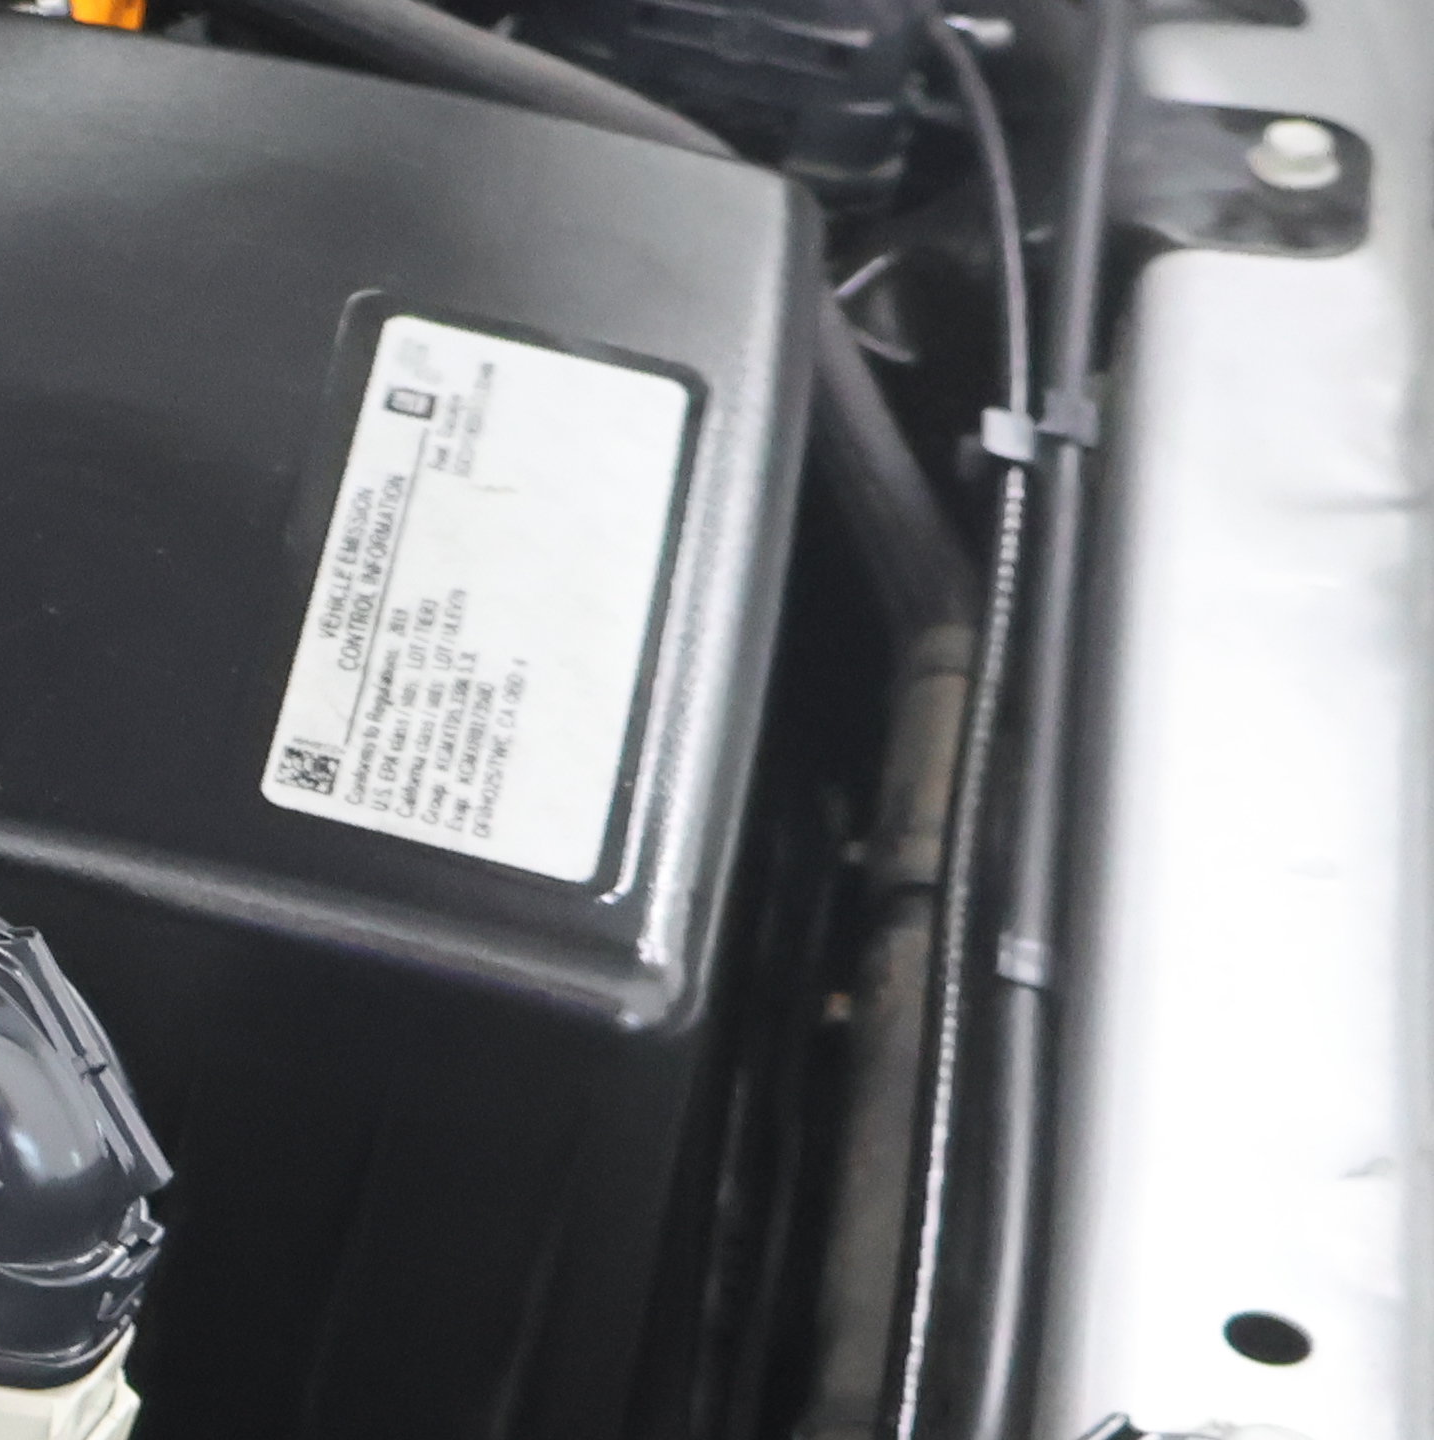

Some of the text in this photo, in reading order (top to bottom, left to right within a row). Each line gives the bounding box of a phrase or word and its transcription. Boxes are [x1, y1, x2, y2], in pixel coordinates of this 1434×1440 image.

[319, 487, 373, 639] VEHICLE EMISSION
[340, 475, 404, 670] CONTROL INFORMATION
